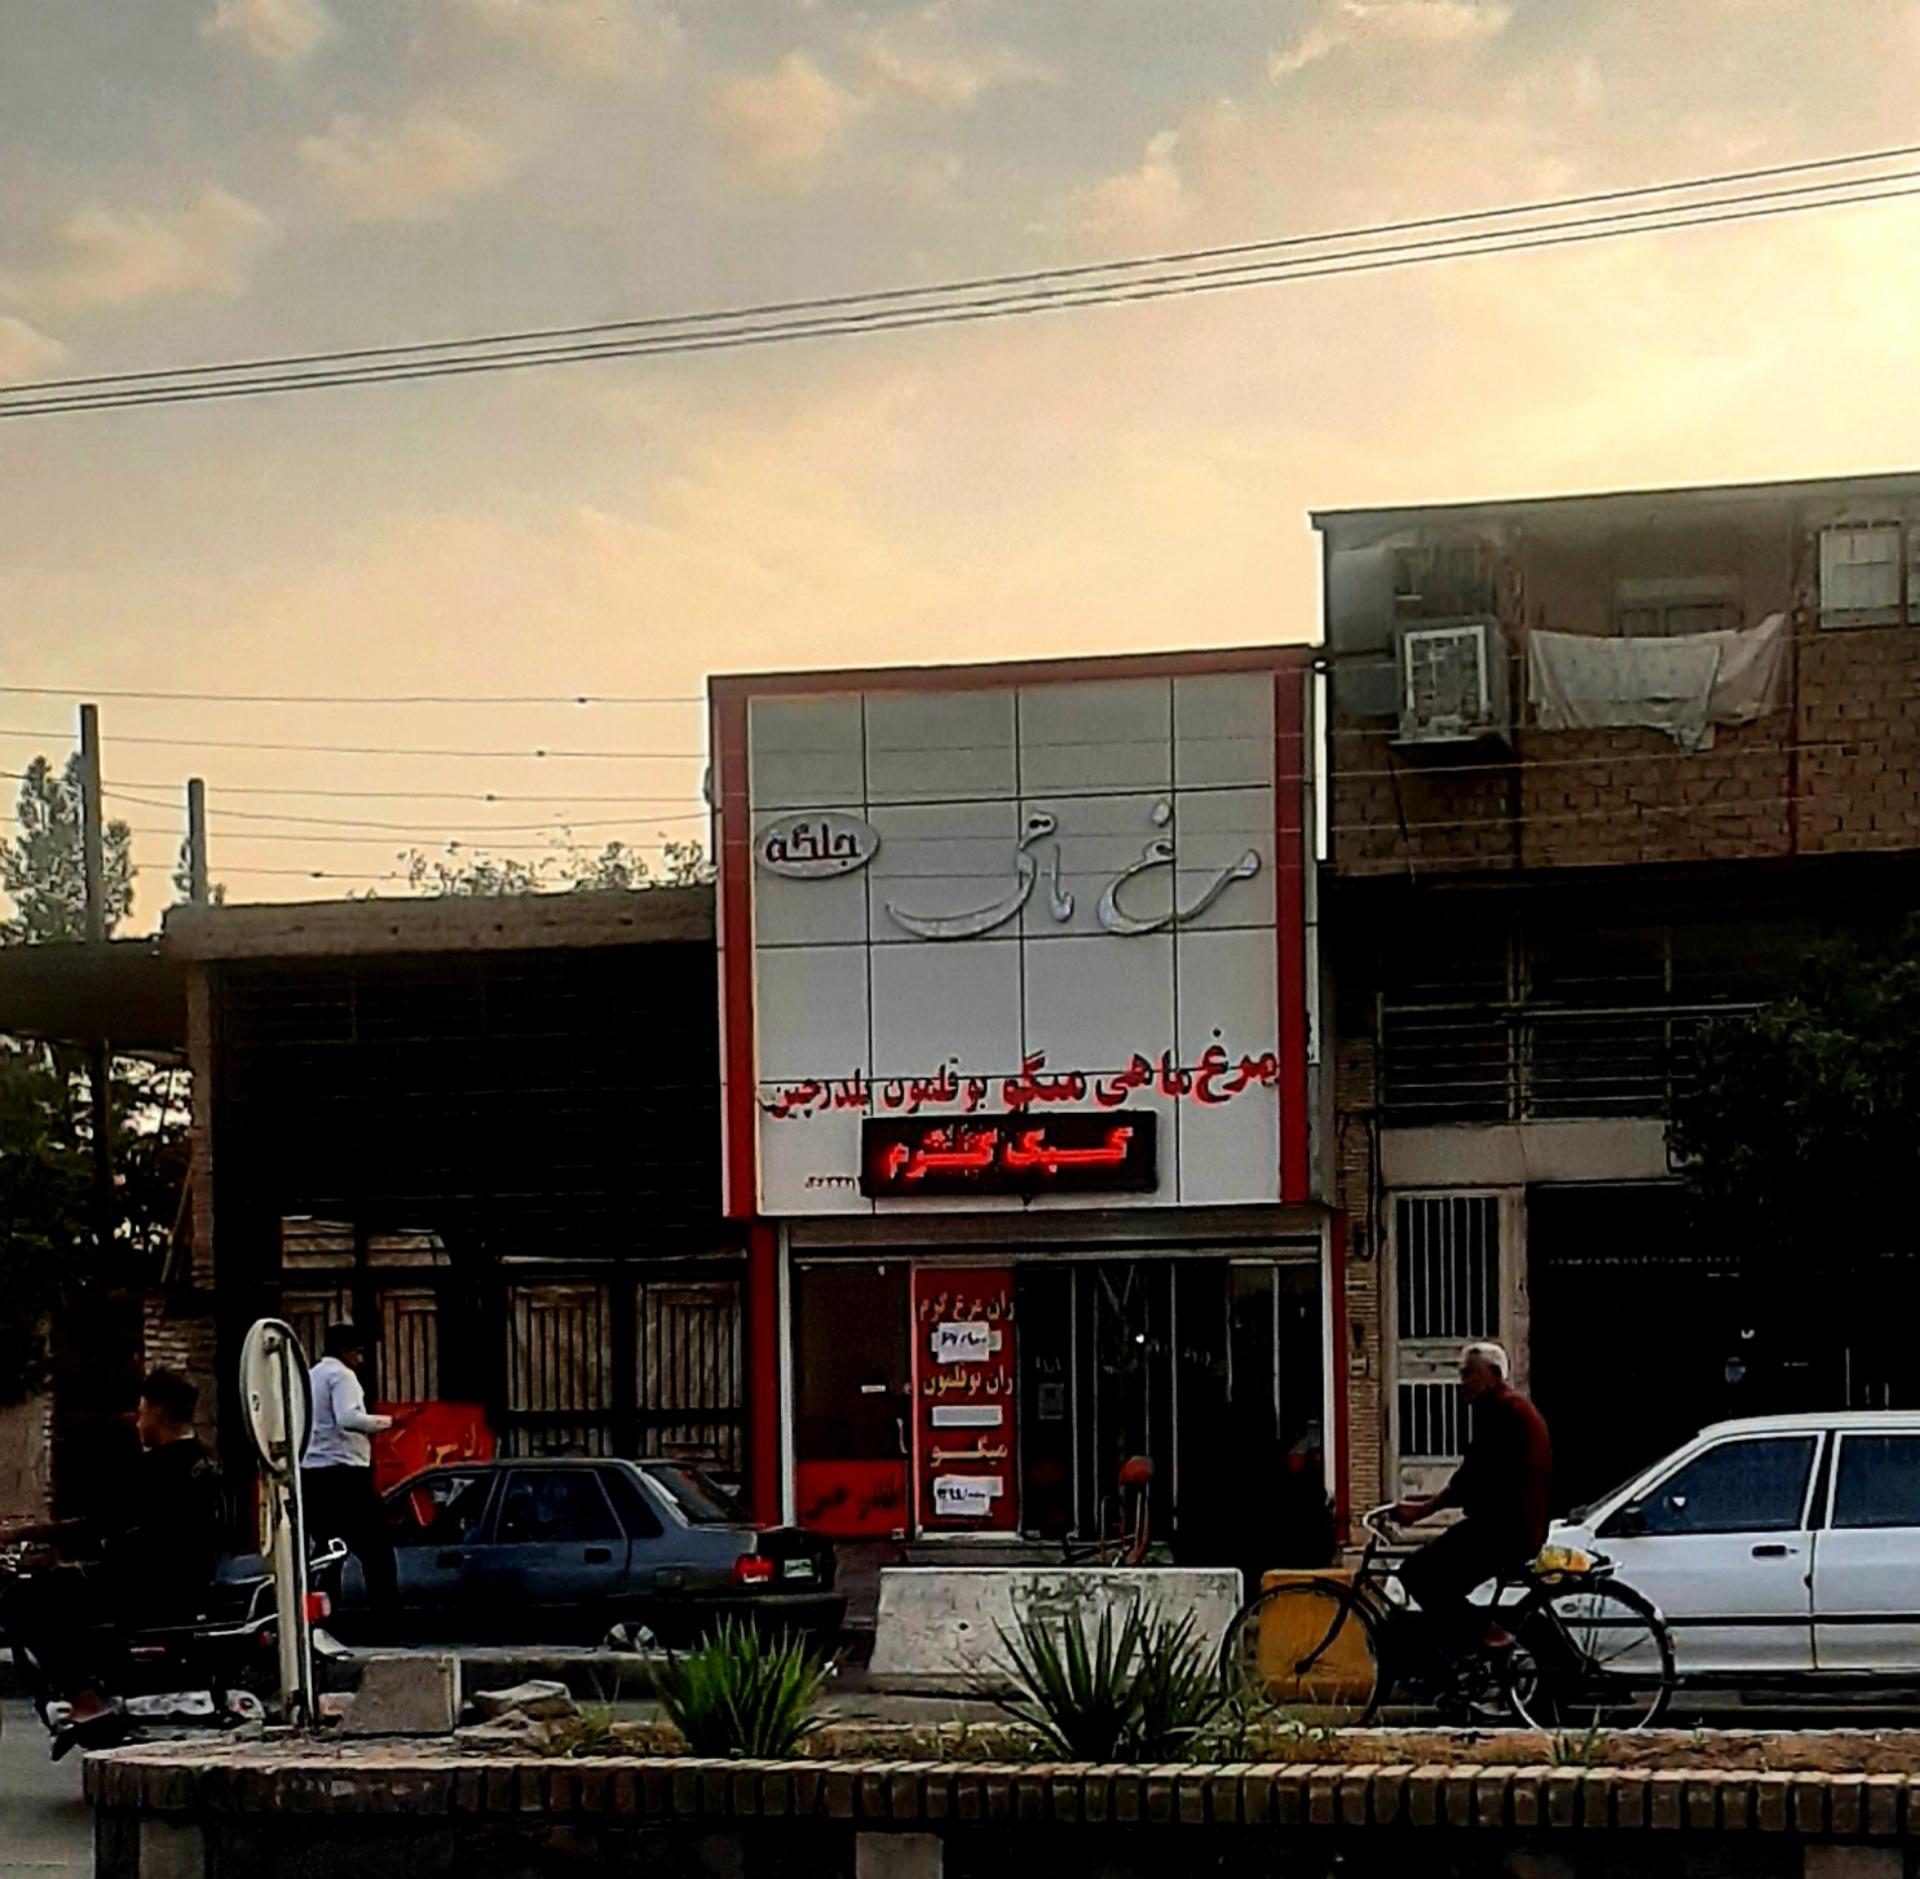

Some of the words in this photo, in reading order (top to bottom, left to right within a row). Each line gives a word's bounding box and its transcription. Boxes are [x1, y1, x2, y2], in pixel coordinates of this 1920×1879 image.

[757, 1067, 871, 1119] بلدرچین
[883, 1057, 989, 1115] بوقلمون
[1003, 1049, 1088, 1114] میگو
[1093, 1049, 1193, 1107] ماهی
[1194, 1026, 1280, 1104] مرغ
[929, 1434, 1009, 1468] میگو
